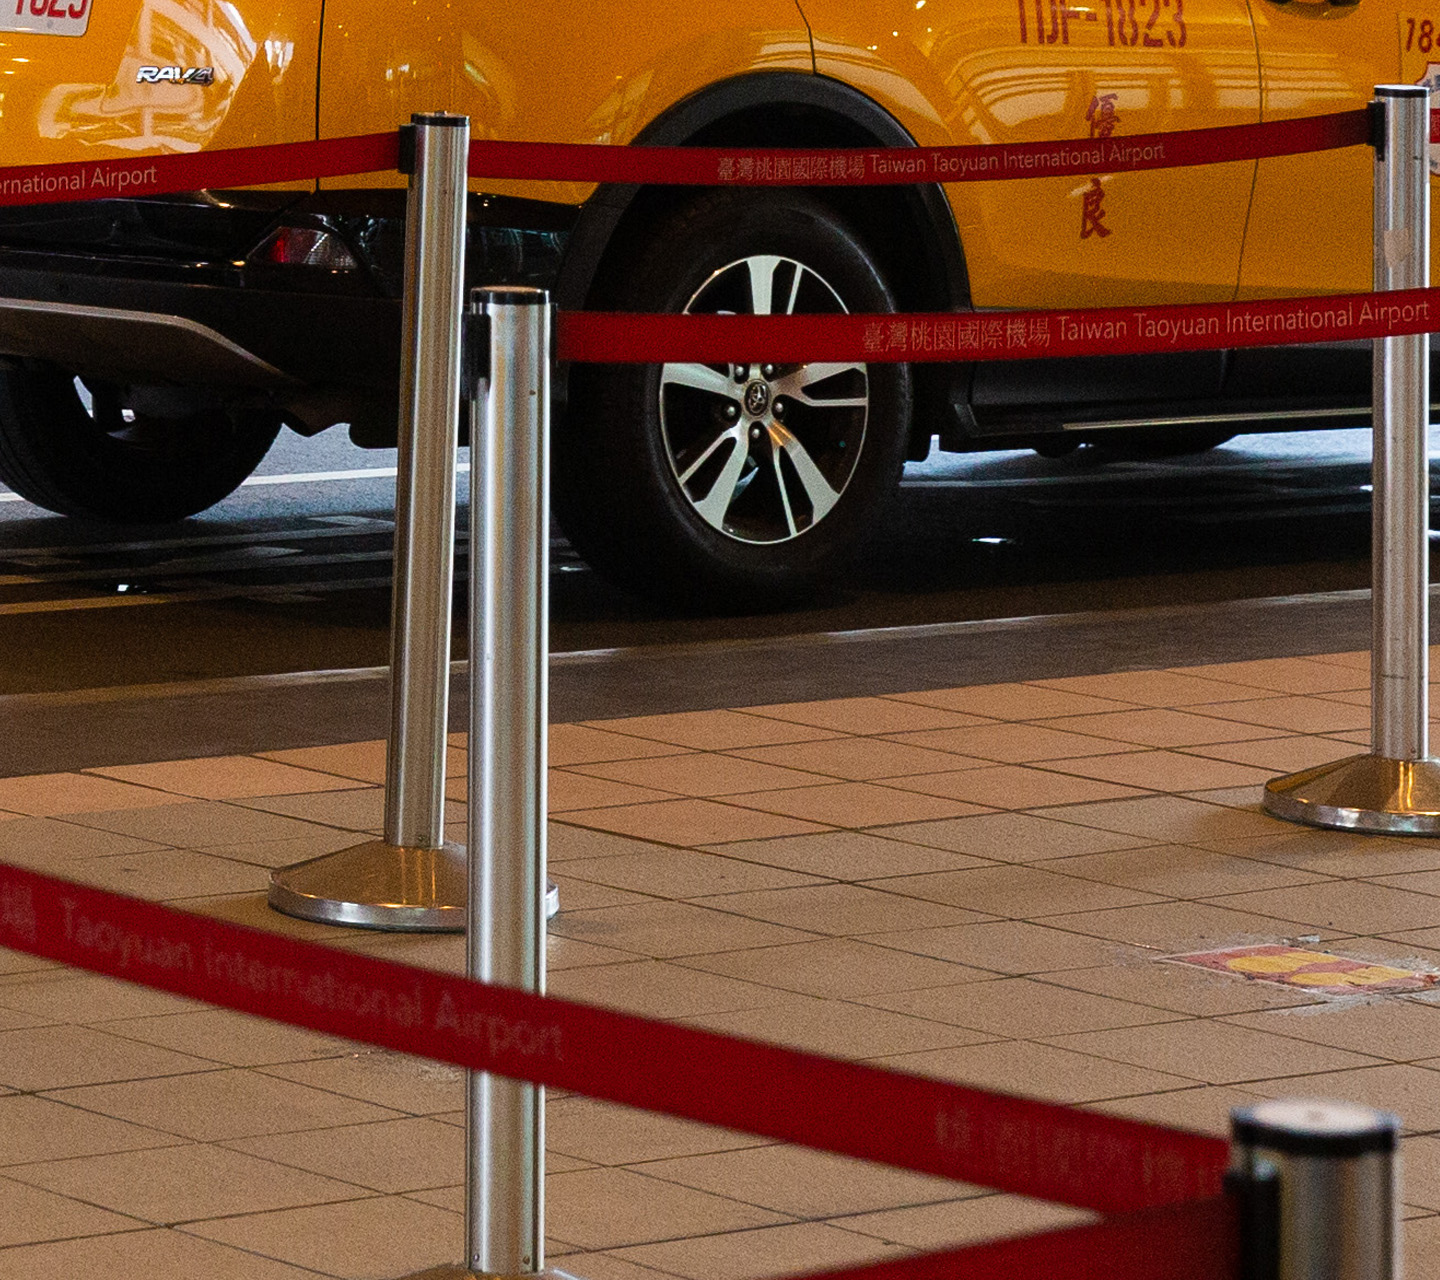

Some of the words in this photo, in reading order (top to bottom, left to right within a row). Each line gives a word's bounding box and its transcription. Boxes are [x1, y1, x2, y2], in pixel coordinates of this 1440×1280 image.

[135, 65, 214, 86] RAV4
[870, 152, 927, 174] Taiwan
[931, 151, 999, 178] Taoyuan
[1003, 143, 1105, 170] International
[1109, 141, 1167, 165] Airport
[89, 163, 158, 192] Airport
[1056, 314, 1128, 341] Taiwan
[1132, 312, 1220, 344] Taoyuan
[1225, 301, 1354, 334] International
[1357, 299, 1431, 331] Airport
